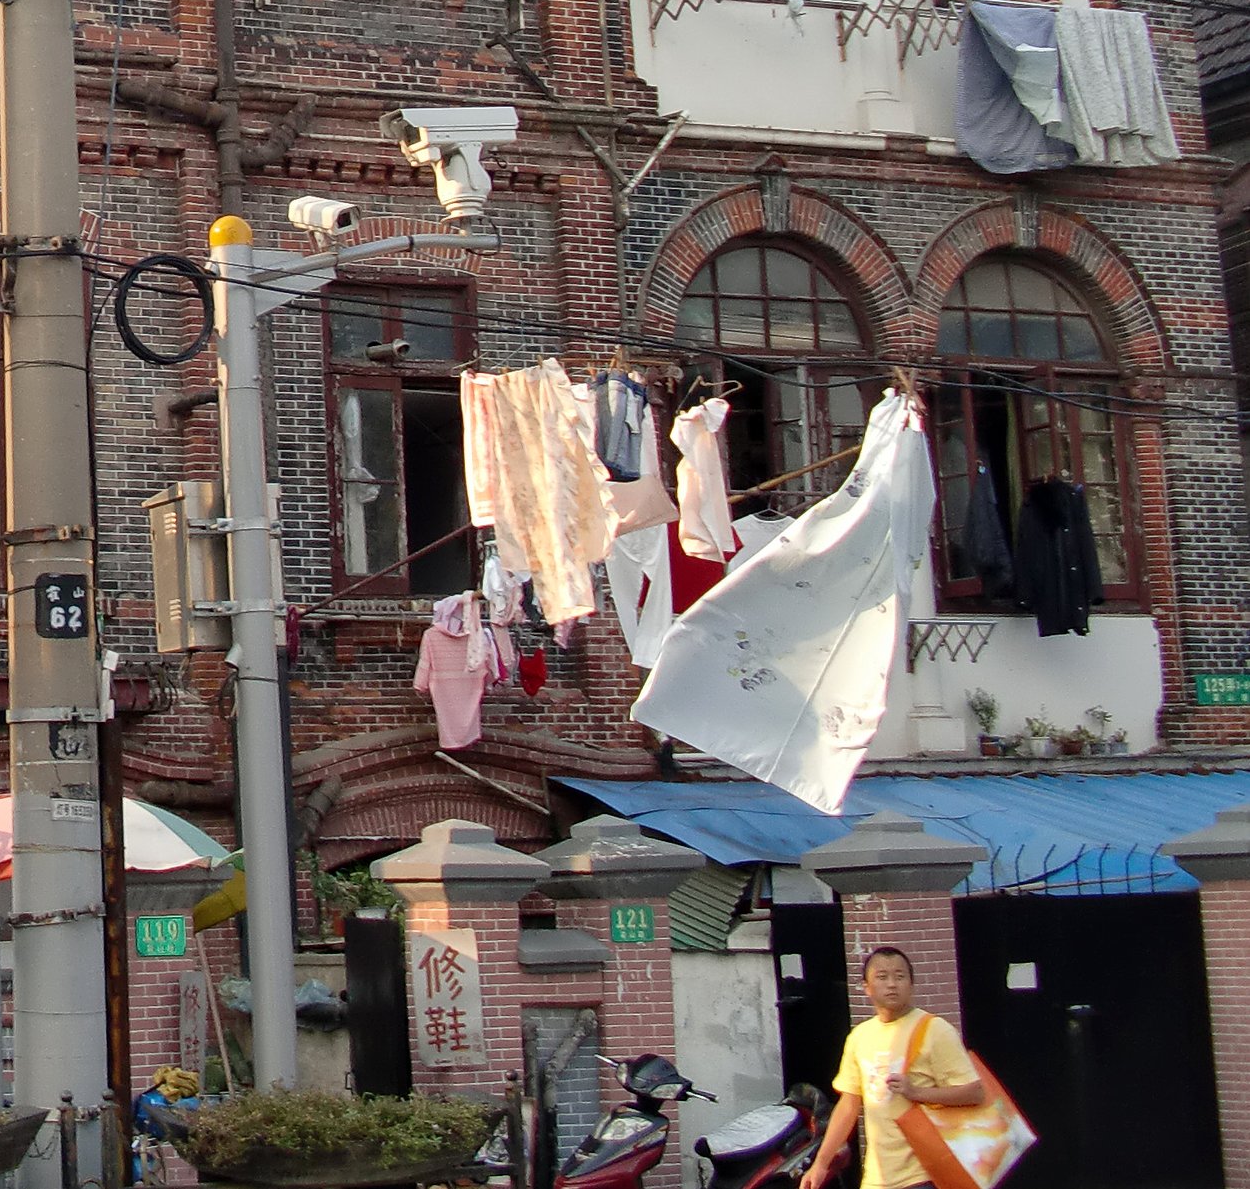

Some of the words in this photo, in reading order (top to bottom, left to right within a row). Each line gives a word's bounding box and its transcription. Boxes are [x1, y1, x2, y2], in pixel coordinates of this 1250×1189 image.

[50, 605, 83, 631] 62
[615, 908, 648, 930] 121
[143, 920, 179, 943] 119
[418, 945, 471, 1054] 修鞋
